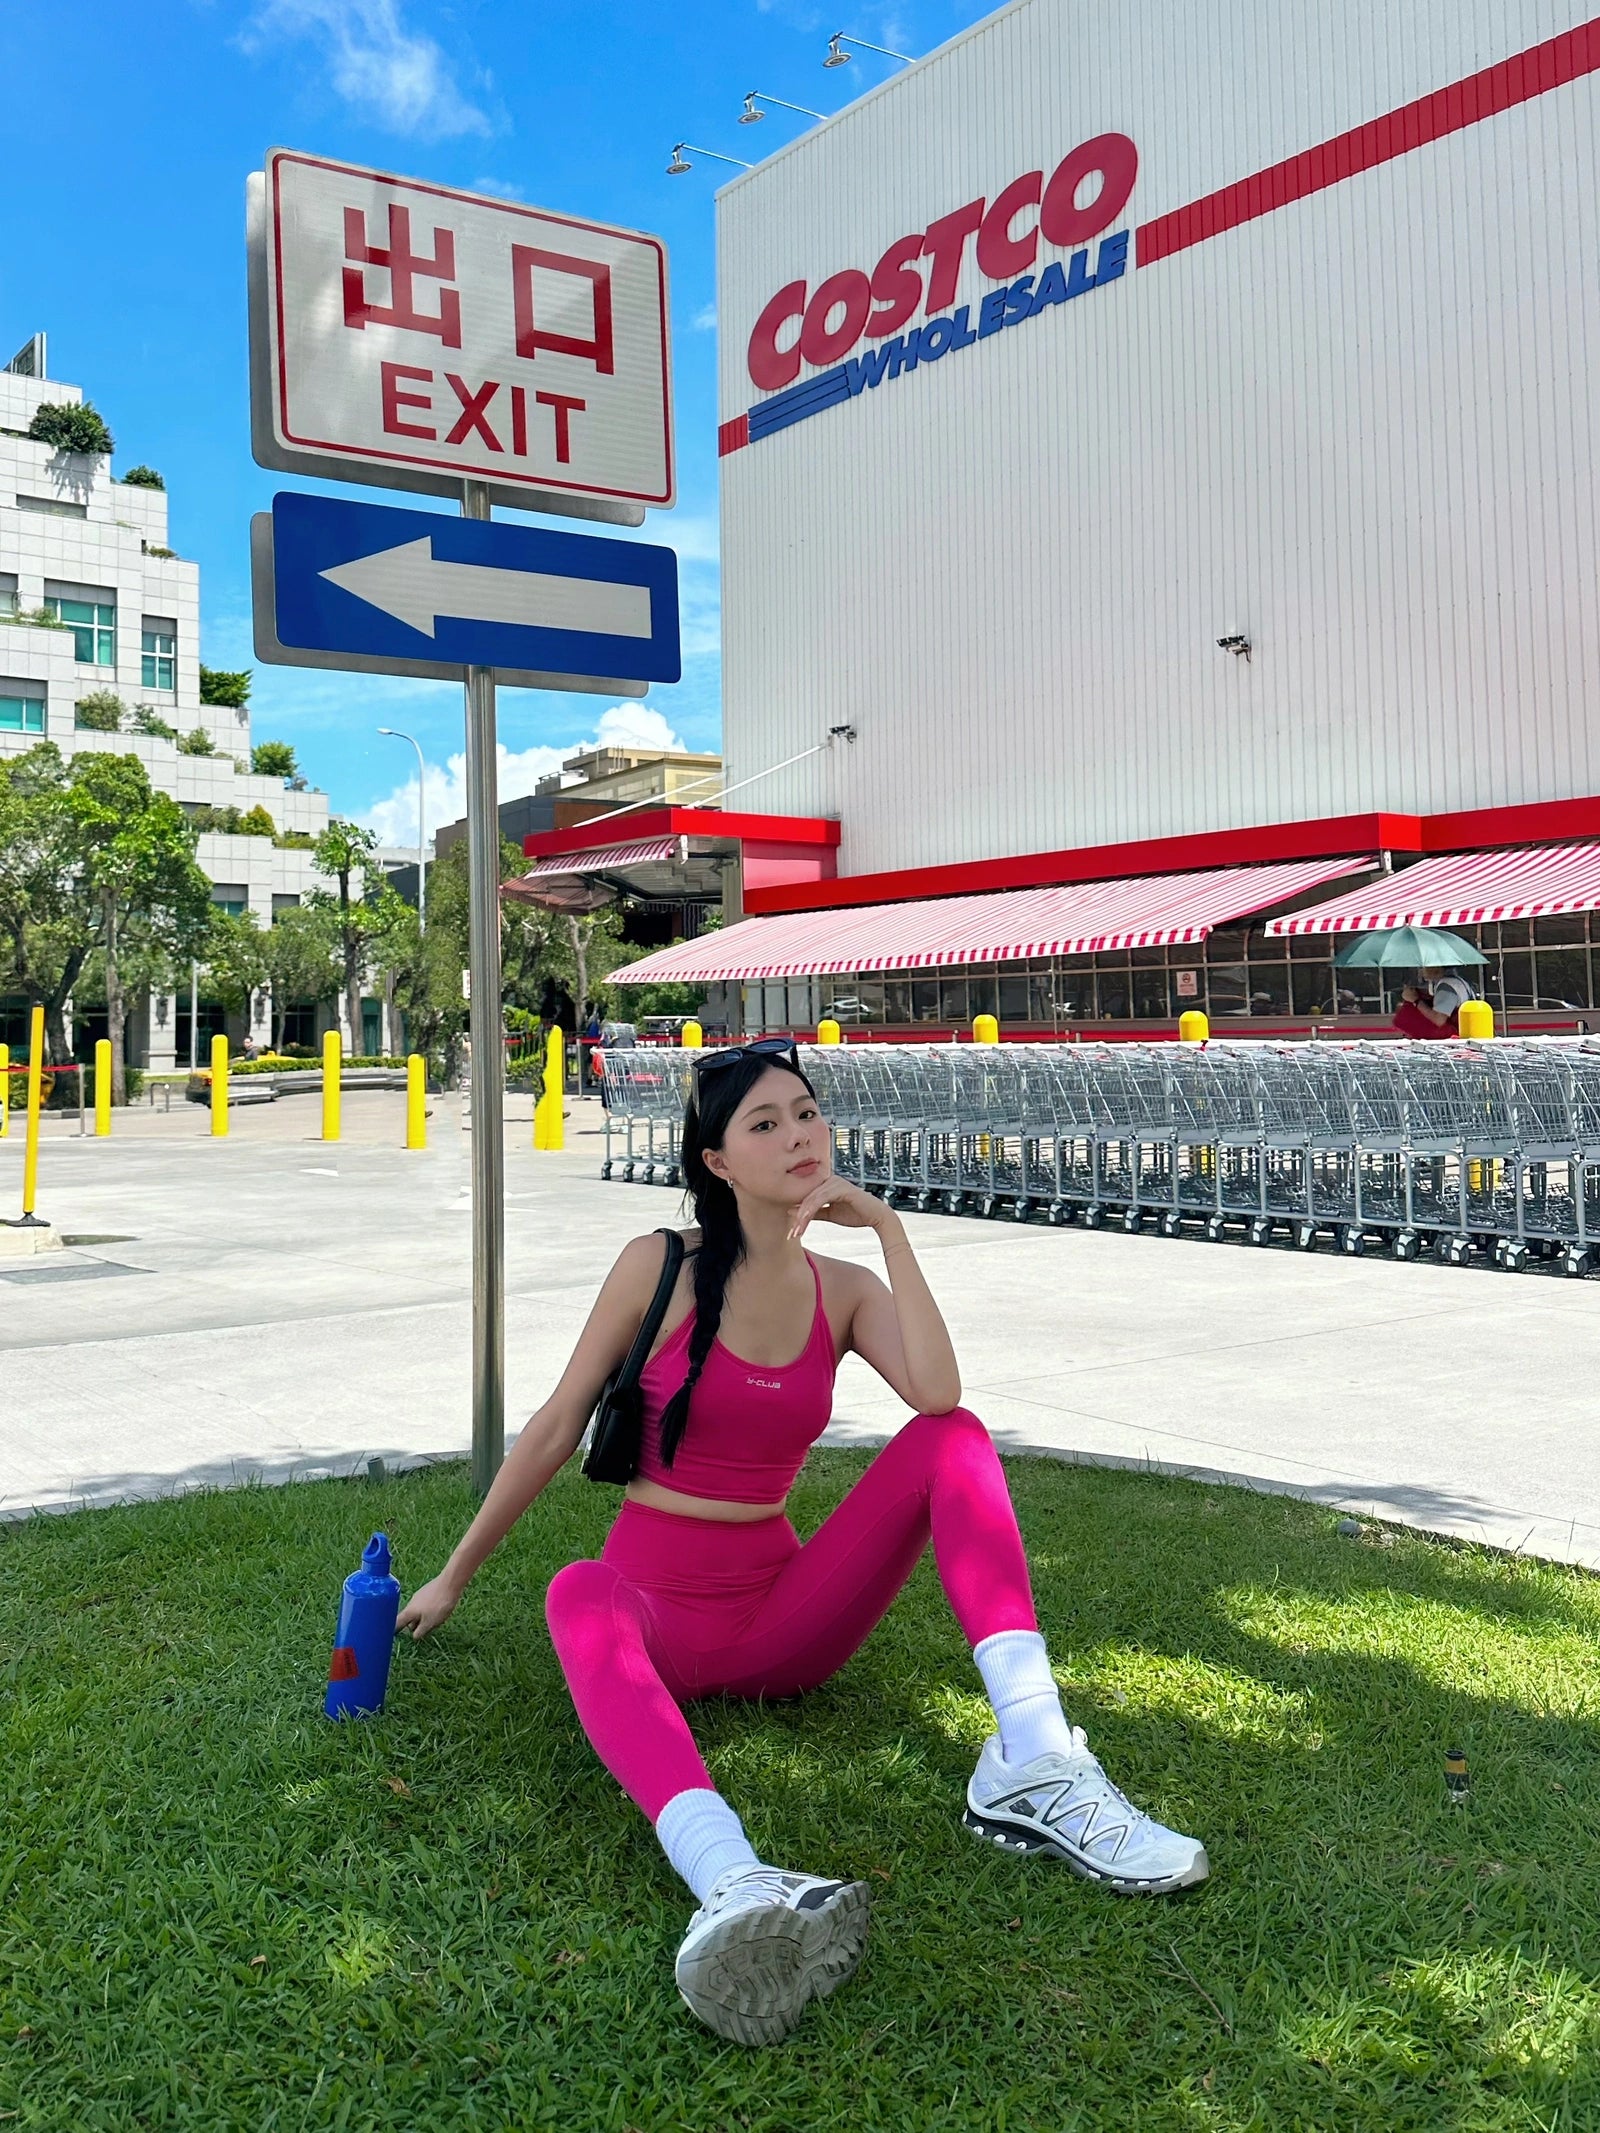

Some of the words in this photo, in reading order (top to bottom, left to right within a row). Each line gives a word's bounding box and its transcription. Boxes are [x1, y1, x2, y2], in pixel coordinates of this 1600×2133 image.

[341, 203, 614, 375] 出口
[747, 132, 1138, 391] COSTCO
[845, 229, 1129, 397] WHOLESALE
[381, 361, 586, 464] EXIT
